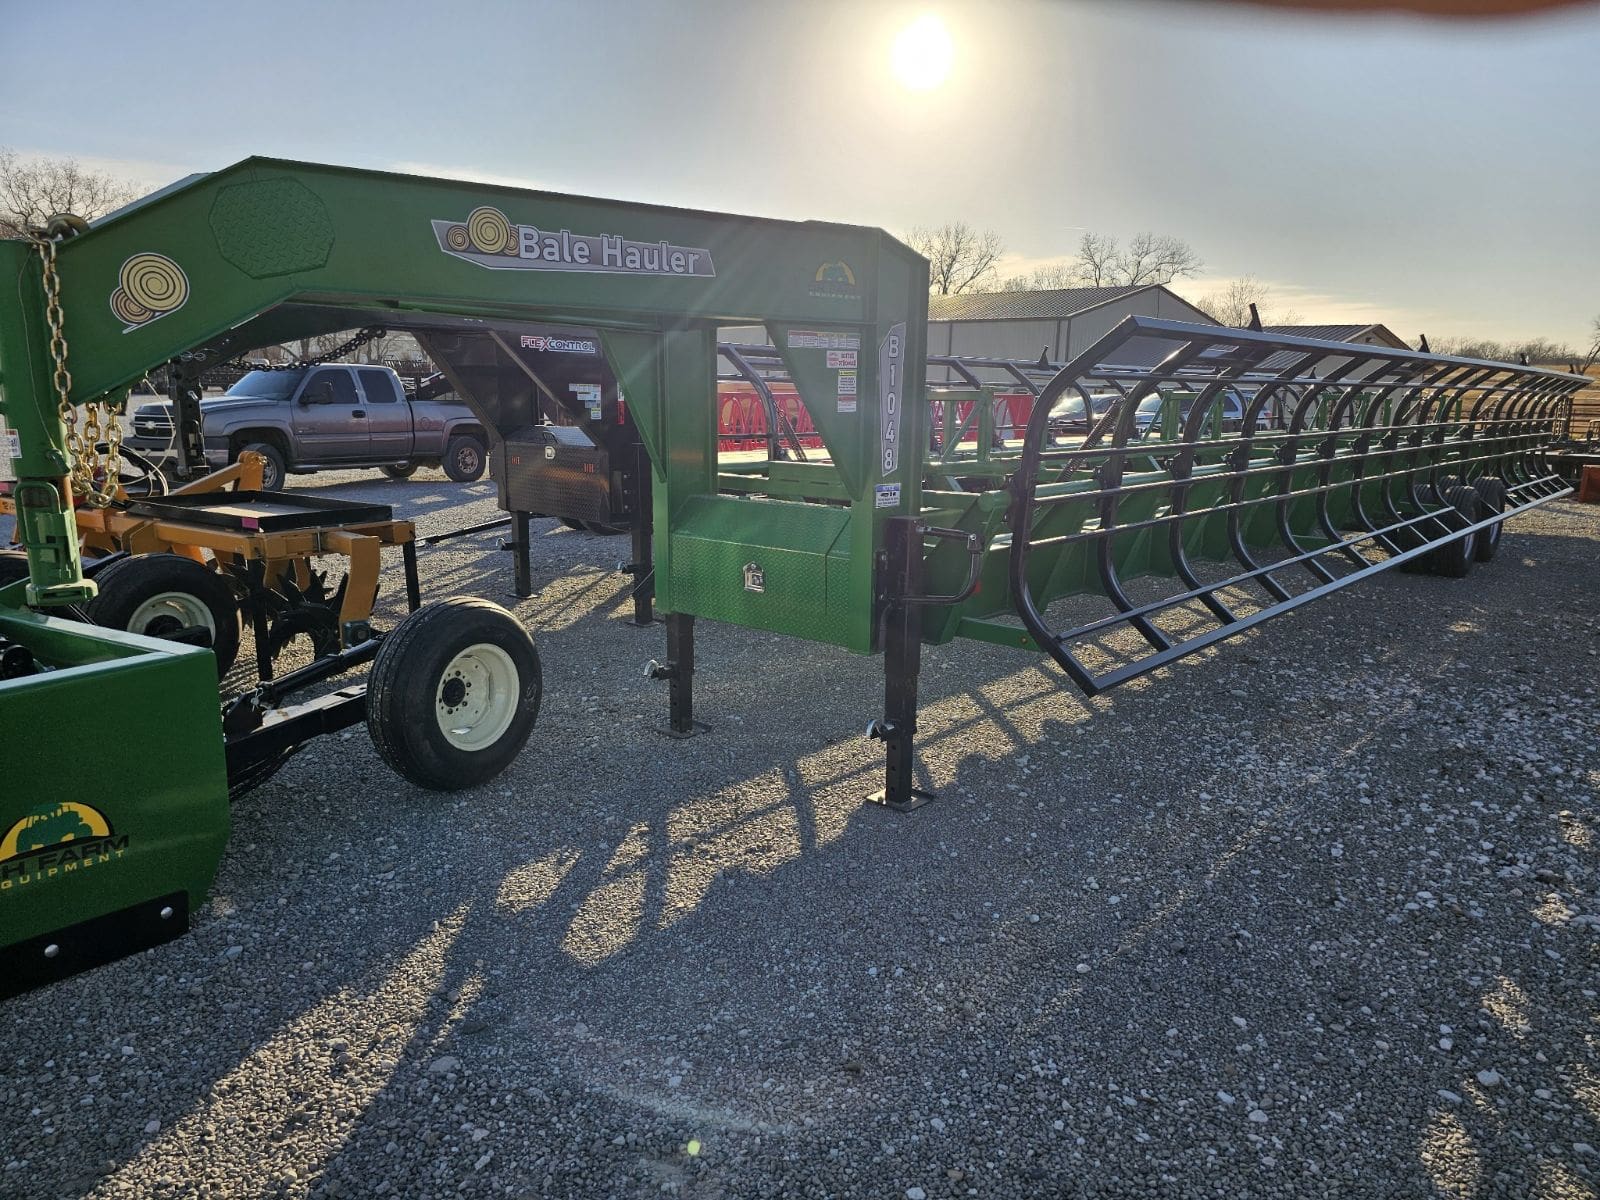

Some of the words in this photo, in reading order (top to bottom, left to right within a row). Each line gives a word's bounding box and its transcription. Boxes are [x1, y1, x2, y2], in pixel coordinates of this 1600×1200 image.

[519, 226, 590, 264] Bale
[602, 235, 700, 274] Hauler
[38, 835, 129, 870] FARM
